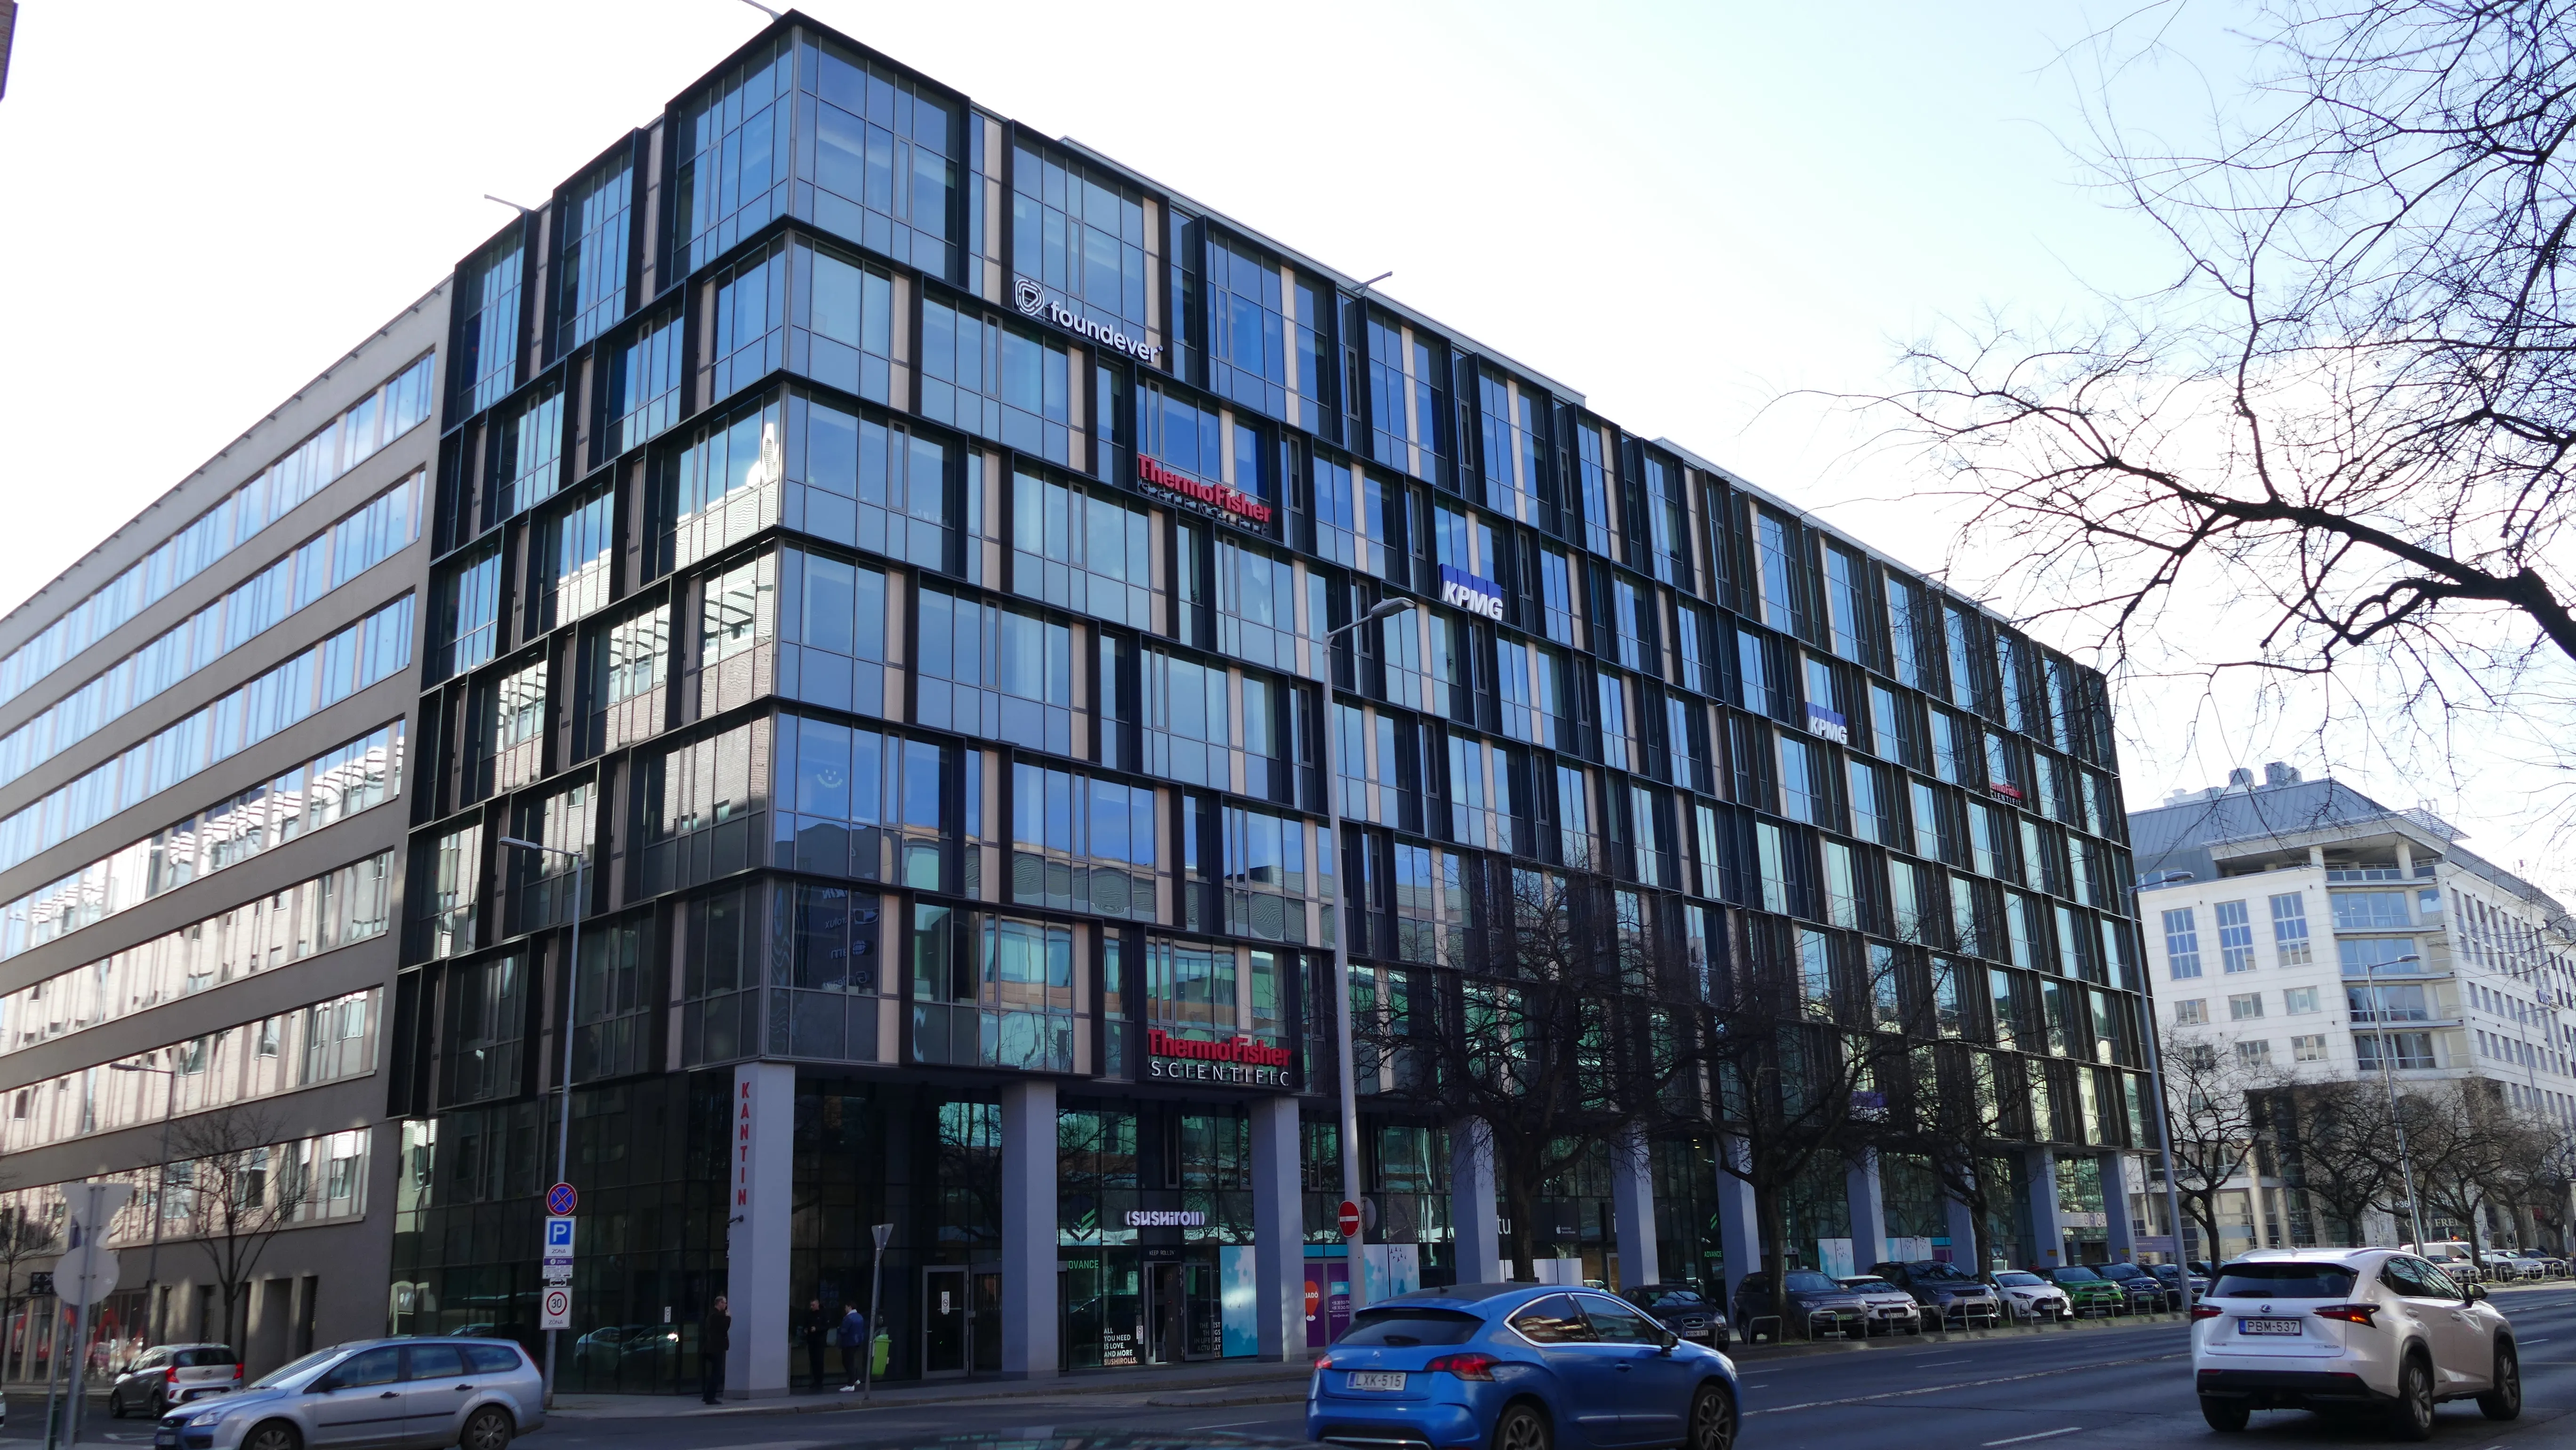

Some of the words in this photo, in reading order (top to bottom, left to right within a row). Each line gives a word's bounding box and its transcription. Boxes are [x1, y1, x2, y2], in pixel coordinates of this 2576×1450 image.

[1051, 300, 1159, 363] foundever
[1441, 580, 1503, 620] KPMG
[1808, 715, 1848, 745] KPMG
[1151, 1061, 1289, 1086] SCIENTIFIC
[738, 1082, 749, 1206] KANTIN
[553, 1224, 567, 1243] P
[552, 1298, 562, 1308] 30
[2247, 1321, 2297, 1332] PBM-537
[1104, 1356, 1137, 1365] SUSHIROLLS.
[1356, 1374, 1402, 1387] LXK-515
